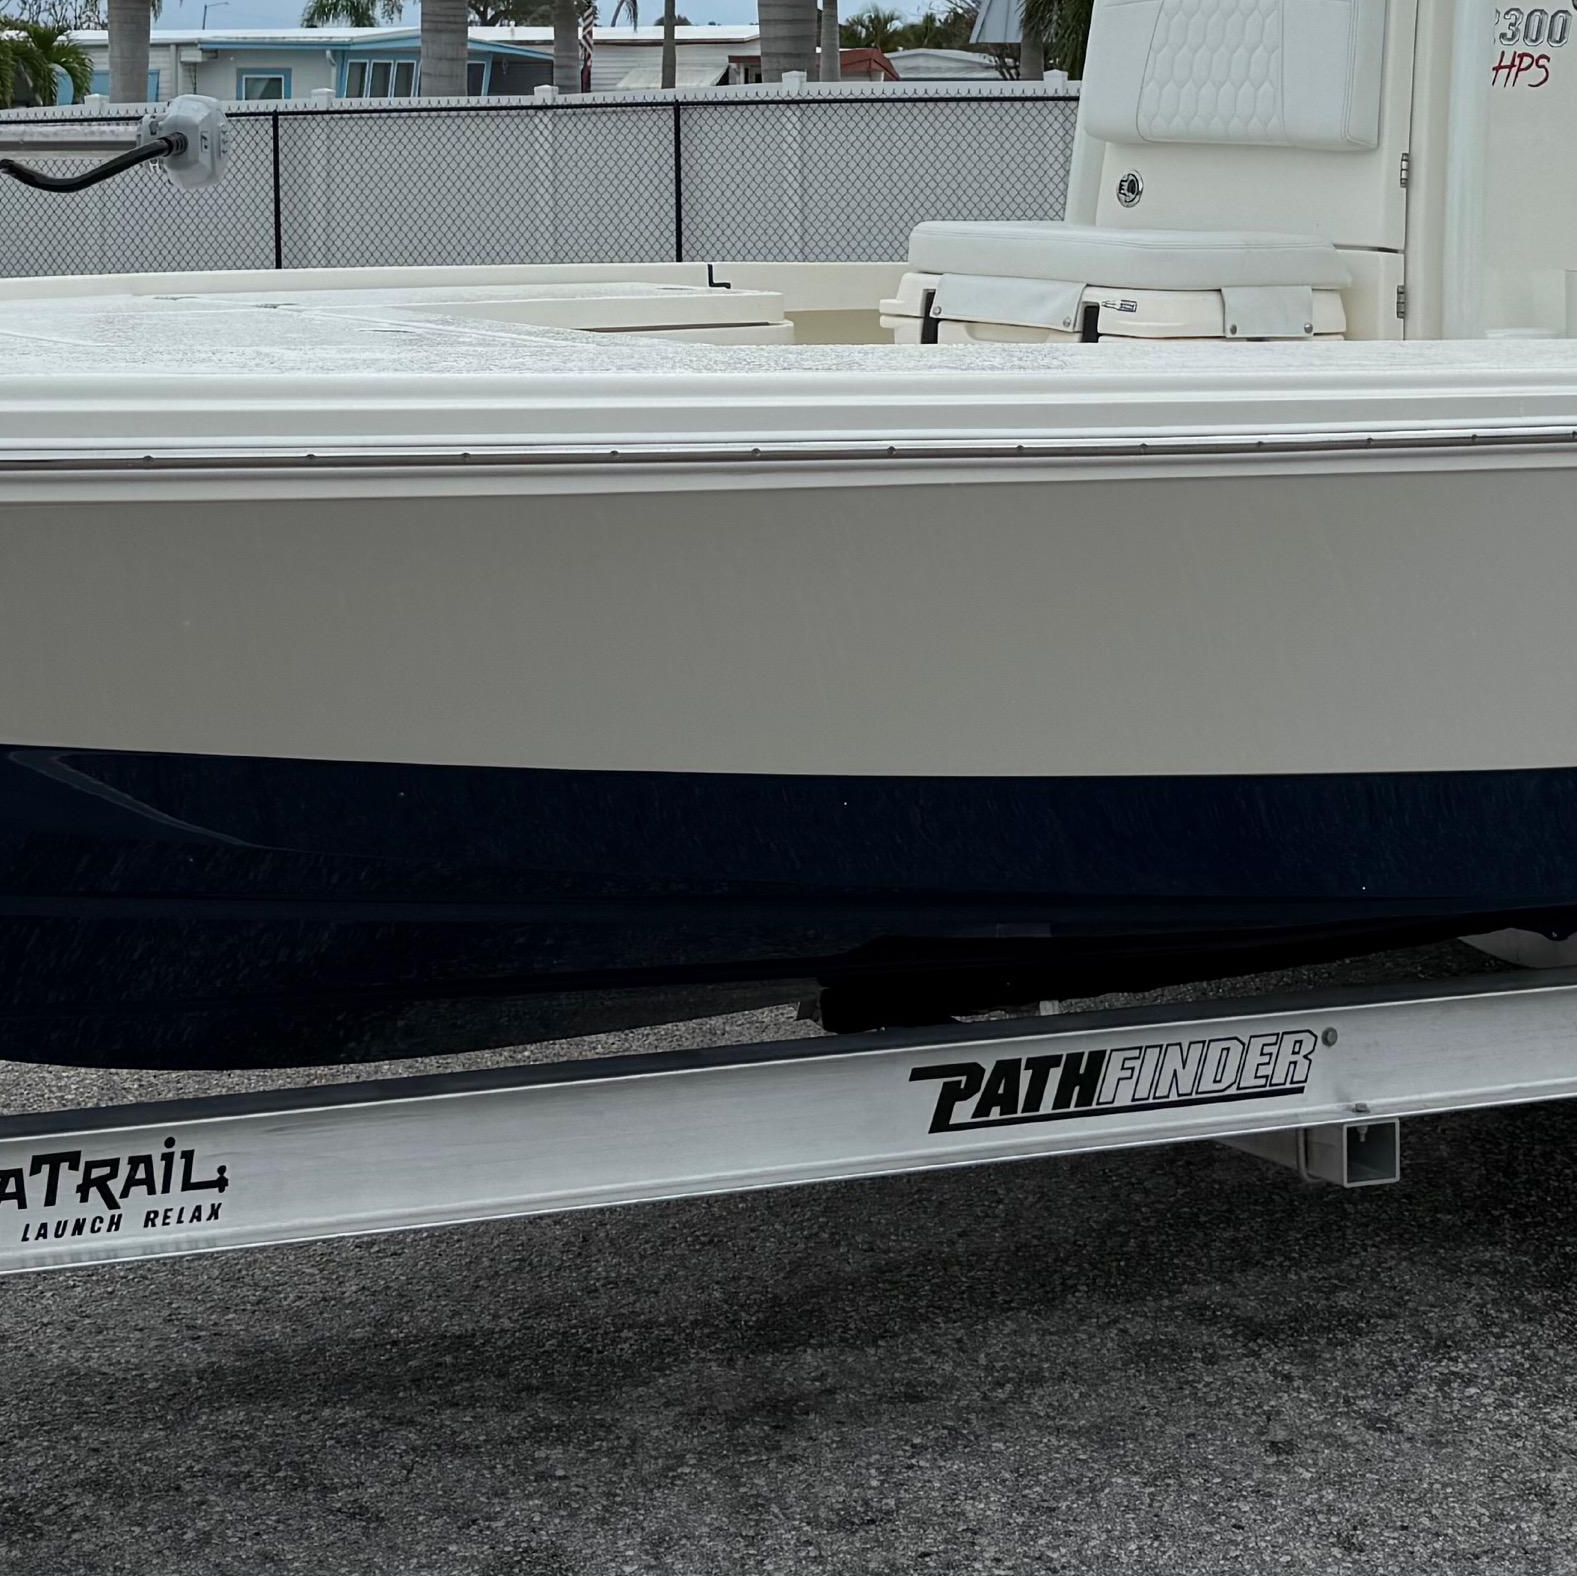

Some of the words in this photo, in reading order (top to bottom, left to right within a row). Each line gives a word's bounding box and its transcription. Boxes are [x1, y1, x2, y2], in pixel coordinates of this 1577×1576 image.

[1493, 7, 1573, 48] 300
[1491, 50, 1551, 88] HPS
[909, 1029, 1317, 1134] PATHFINDER
[21, 1213, 122, 1242] LAUNCH
[143, 1202, 222, 1228] RELAX
